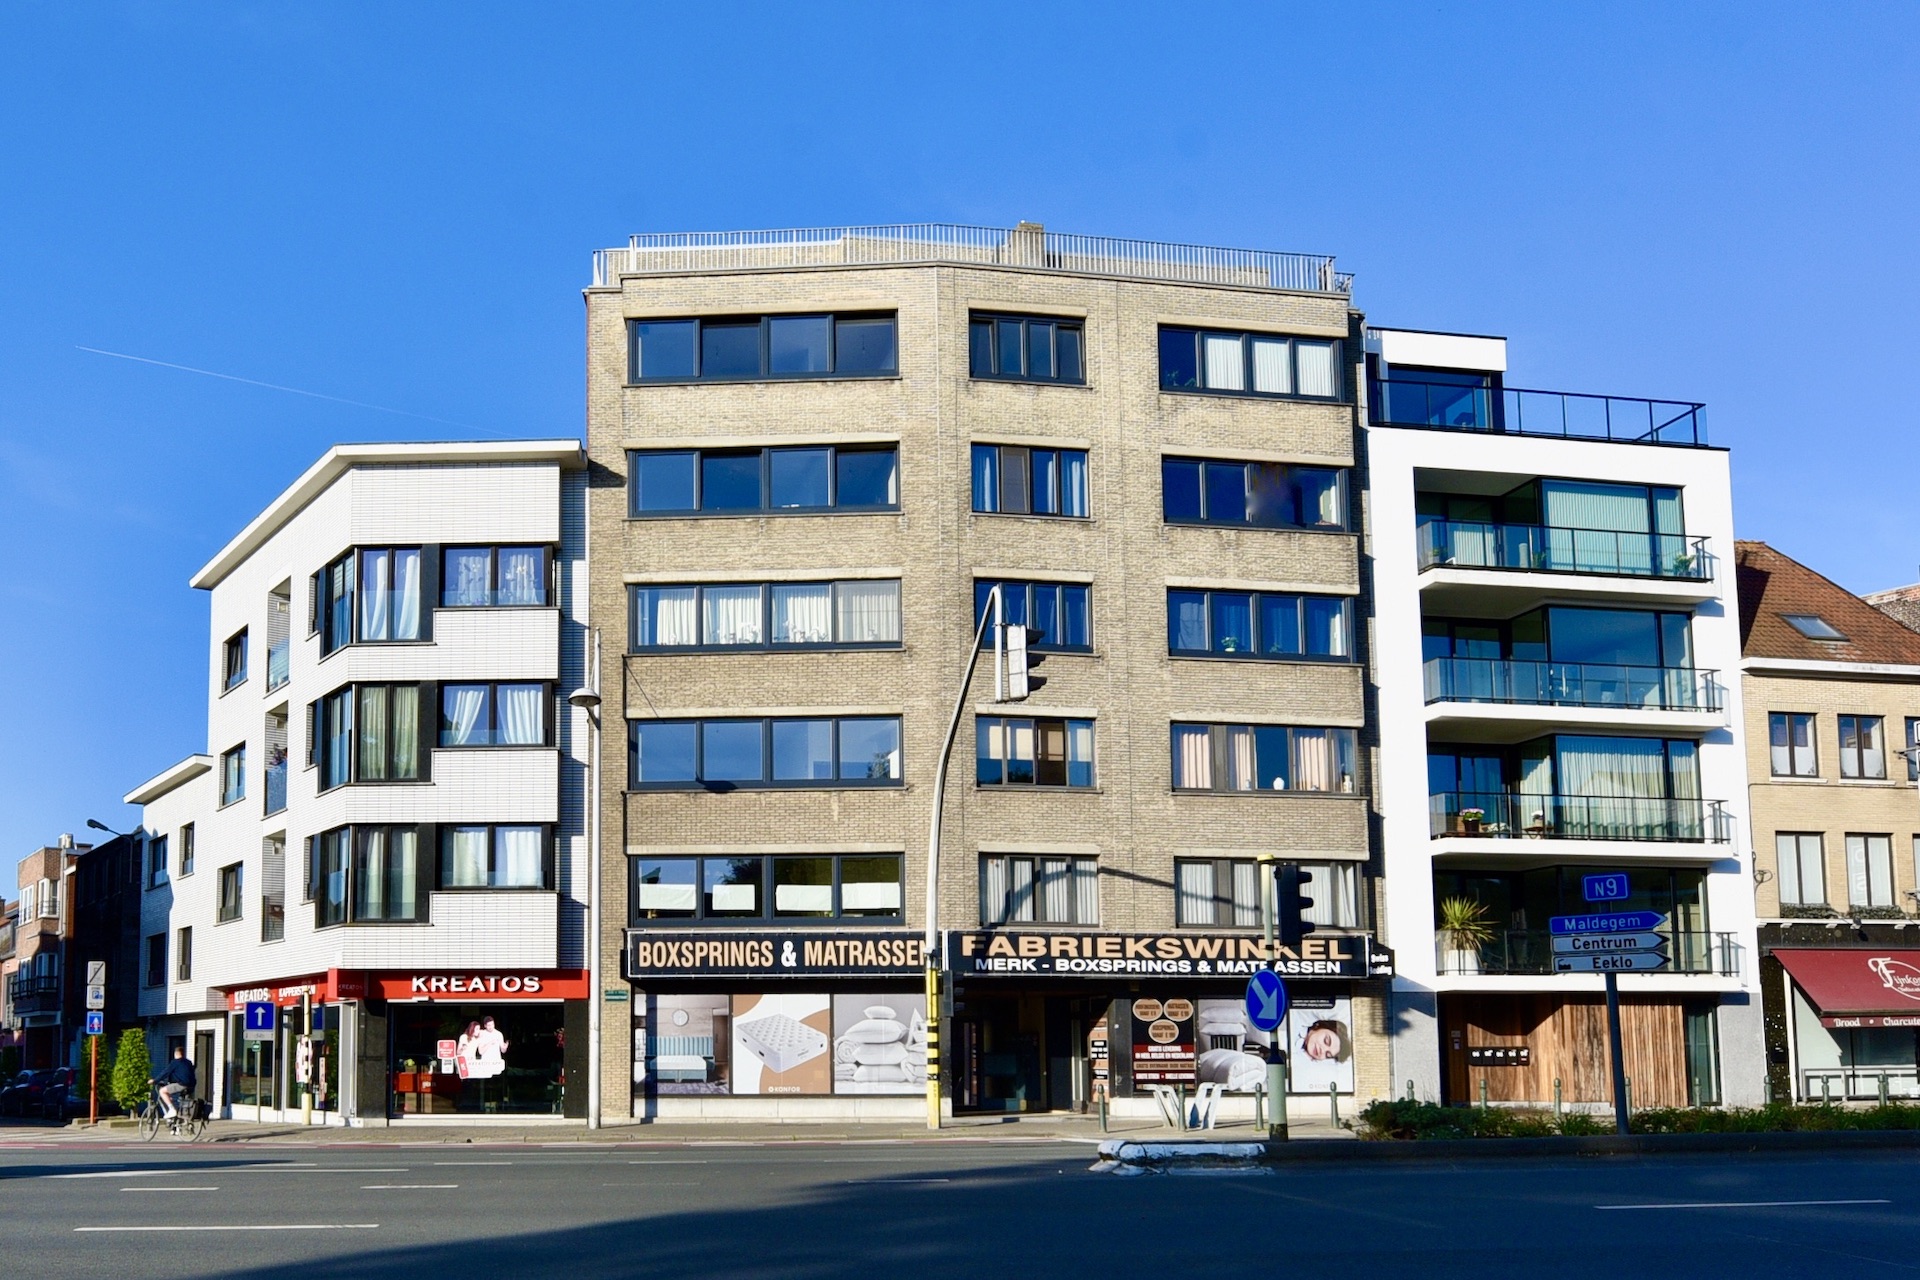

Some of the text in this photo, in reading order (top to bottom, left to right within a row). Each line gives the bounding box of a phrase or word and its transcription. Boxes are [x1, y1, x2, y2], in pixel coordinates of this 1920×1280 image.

[1594, 878, 1617, 896] N9
[1564, 916, 1640, 931] Maldegem
[1572, 937, 1637, 950] Centrum
[639, 941, 773, 967] BOXSPRINGS
[780, 940, 797, 968] &
[975, 958, 1037, 971] MERK
[1055, 959, 1191, 973] BOXSPRINGS
[1197, 960, 1211, 973] &
[1592, 956, 1633, 969] Eeklo
[411, 976, 541, 992] KREATOS
[234, 988, 268, 1004] KREATOS
[1833, 1018, 1860, 1027] Brood
